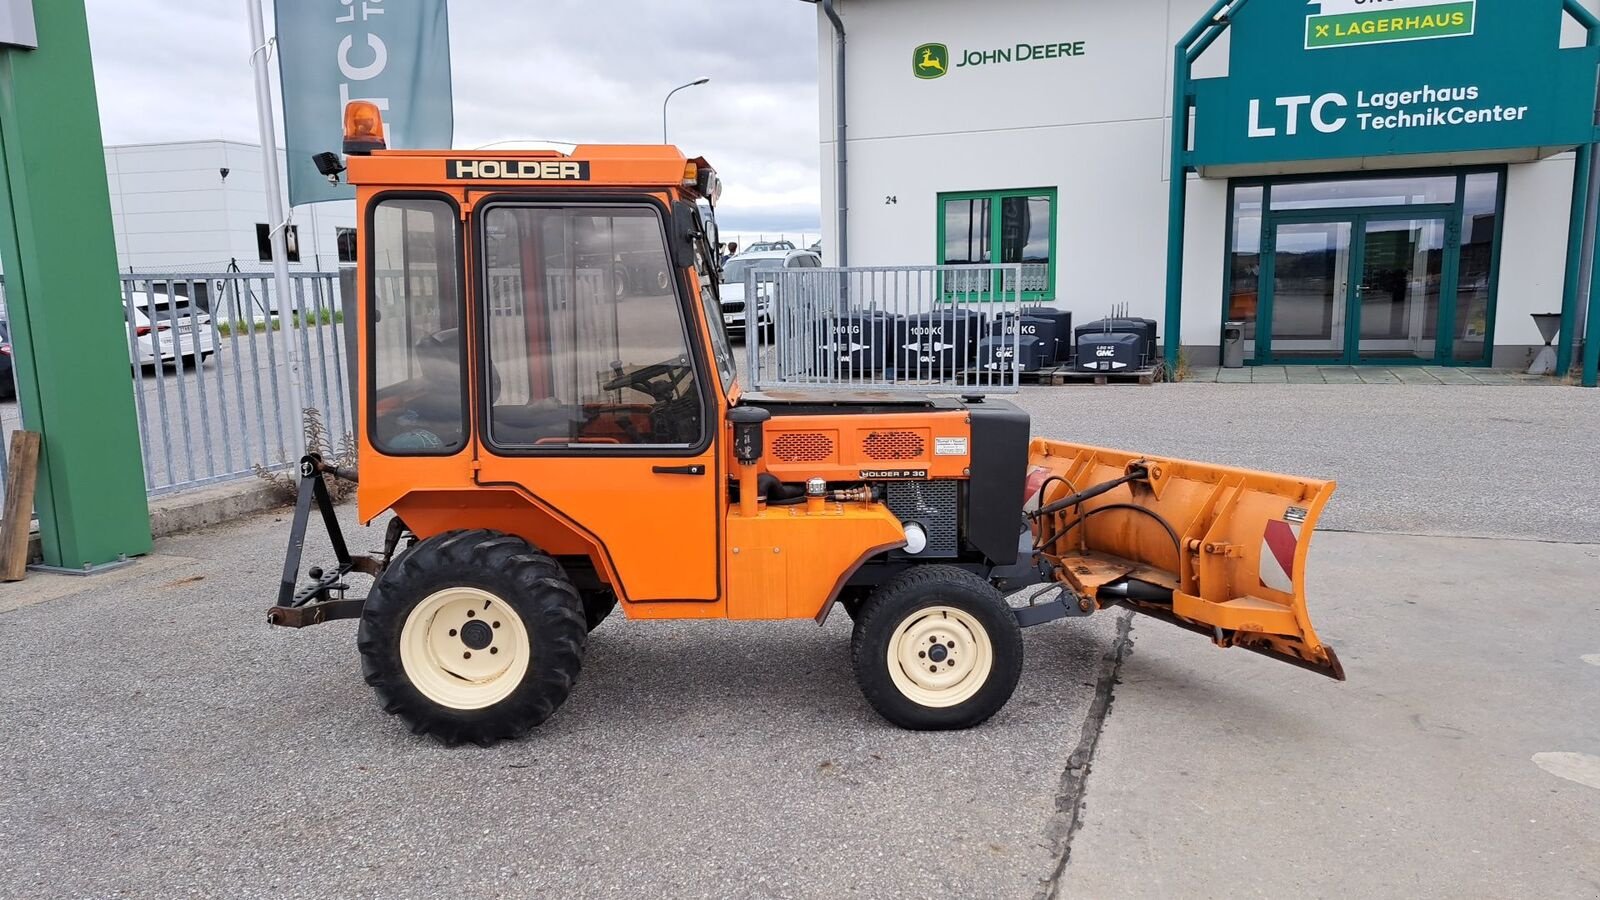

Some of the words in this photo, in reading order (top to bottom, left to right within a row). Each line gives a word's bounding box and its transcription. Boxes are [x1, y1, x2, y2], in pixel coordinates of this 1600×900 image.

[1335, 12, 1464, 36] LAGERHAUS
[956, 49, 1011, 67] JOHN
[1015, 41, 1086, 61] DEERE
[1357, 84, 1479, 110] Lagerhaus
[1248, 92, 1348, 138] LTC
[1356, 104, 1528, 130] TechnikCenter
[455, 160, 580, 179] HOLDER
[885, 195, 897, 205] 24
[1021, 325, 1036, 334] KG
